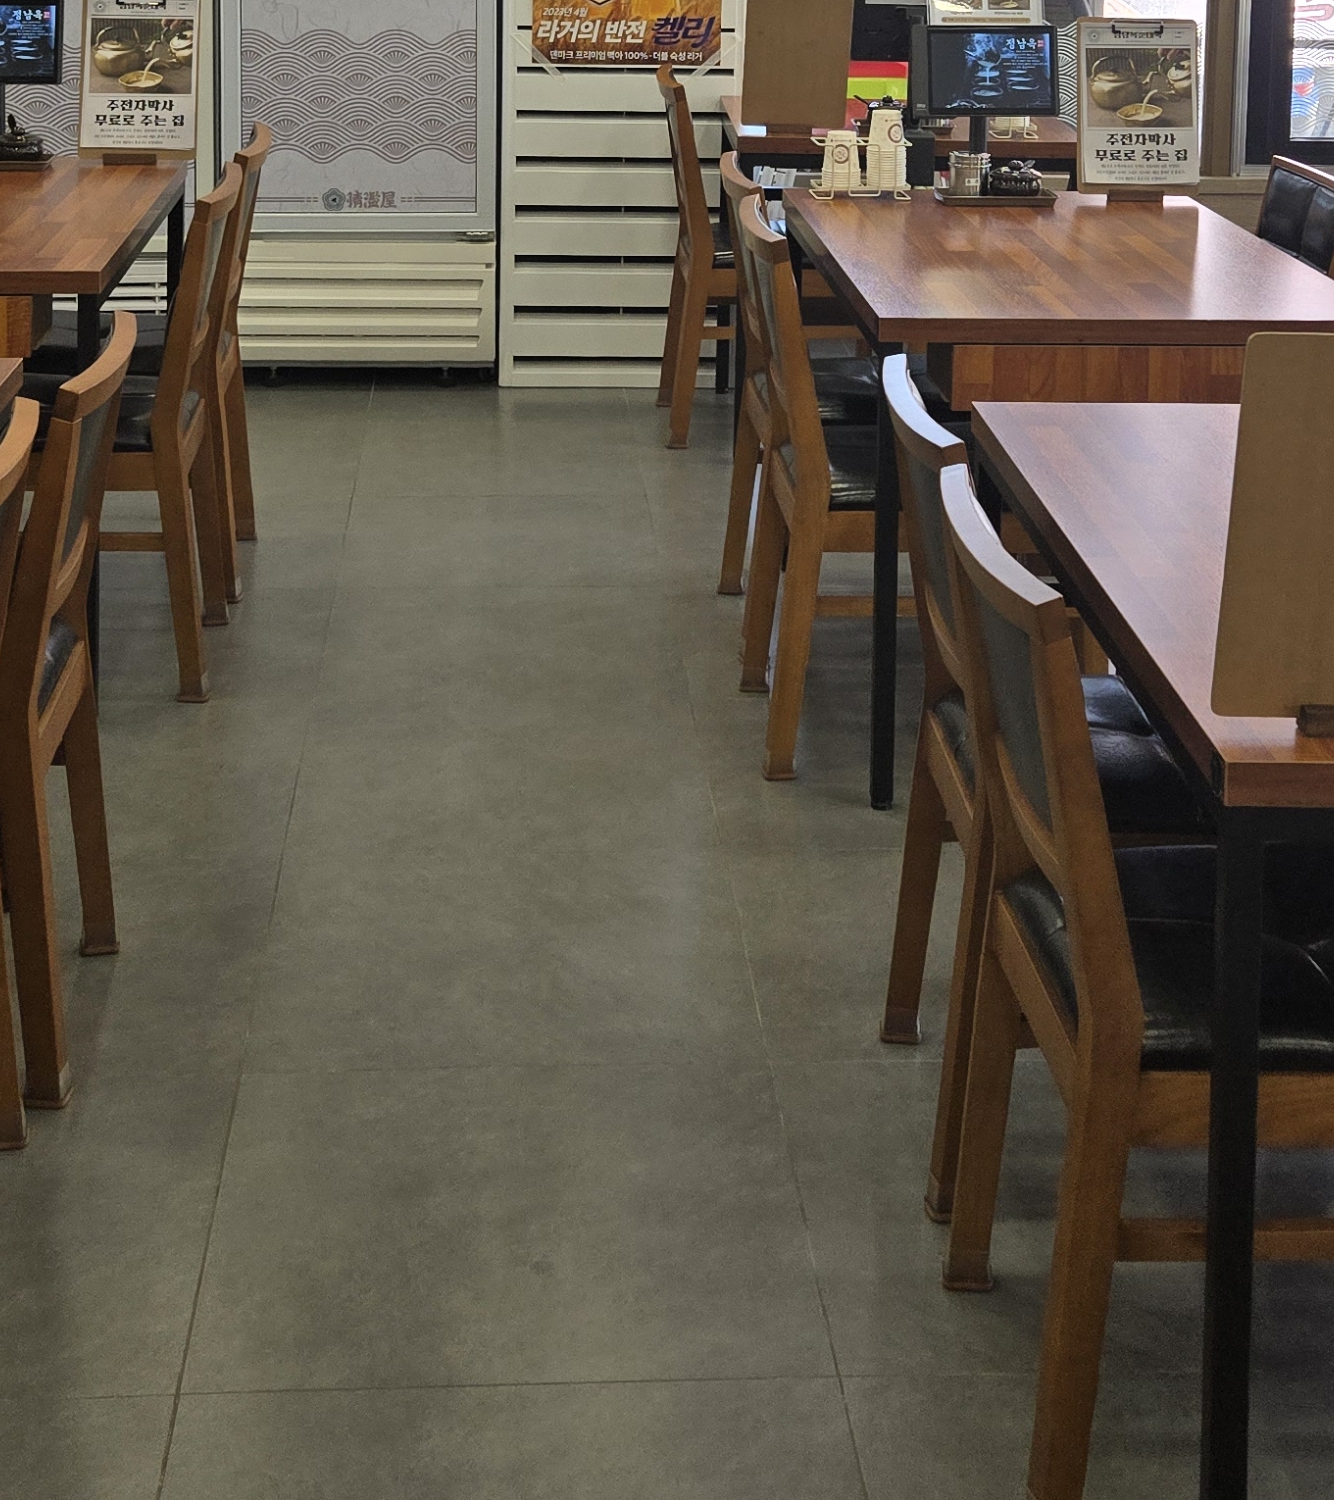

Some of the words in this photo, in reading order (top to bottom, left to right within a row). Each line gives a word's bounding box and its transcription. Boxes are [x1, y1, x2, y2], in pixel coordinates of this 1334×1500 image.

[11, 9, 43, 21] 정남옥
[543, 7, 573, 17] 2023년
[573, 7, 589, 17] 4월
[537, 19, 599, 43] 라거의
[604, 19, 648, 44] 반전
[651, 15, 716, 49] 켈리
[1005, 37, 1037, 50] 정남옥
[549, 50, 574, 60] 덴마크
[575, 51, 606, 61] 프리미엄
[607, 51, 623, 61] 맥아
[669, 51, 686, 61] 숙성
[686, 51, 703, 62] 라거
[106, 99, 175, 112] 주전자막사
[94, 114, 136, 126] 무료로
[140, 114, 167, 127] 주는
[172, 114, 185, 127] 집
[1106, 133, 1177, 146] 주전자막사
[1095, 149, 1137, 162] 무료로
[1141, 149, 1170, 162] 주는
[1174, 149, 1189, 162] 집
[347, 190, 397, 209] 情濫屋
